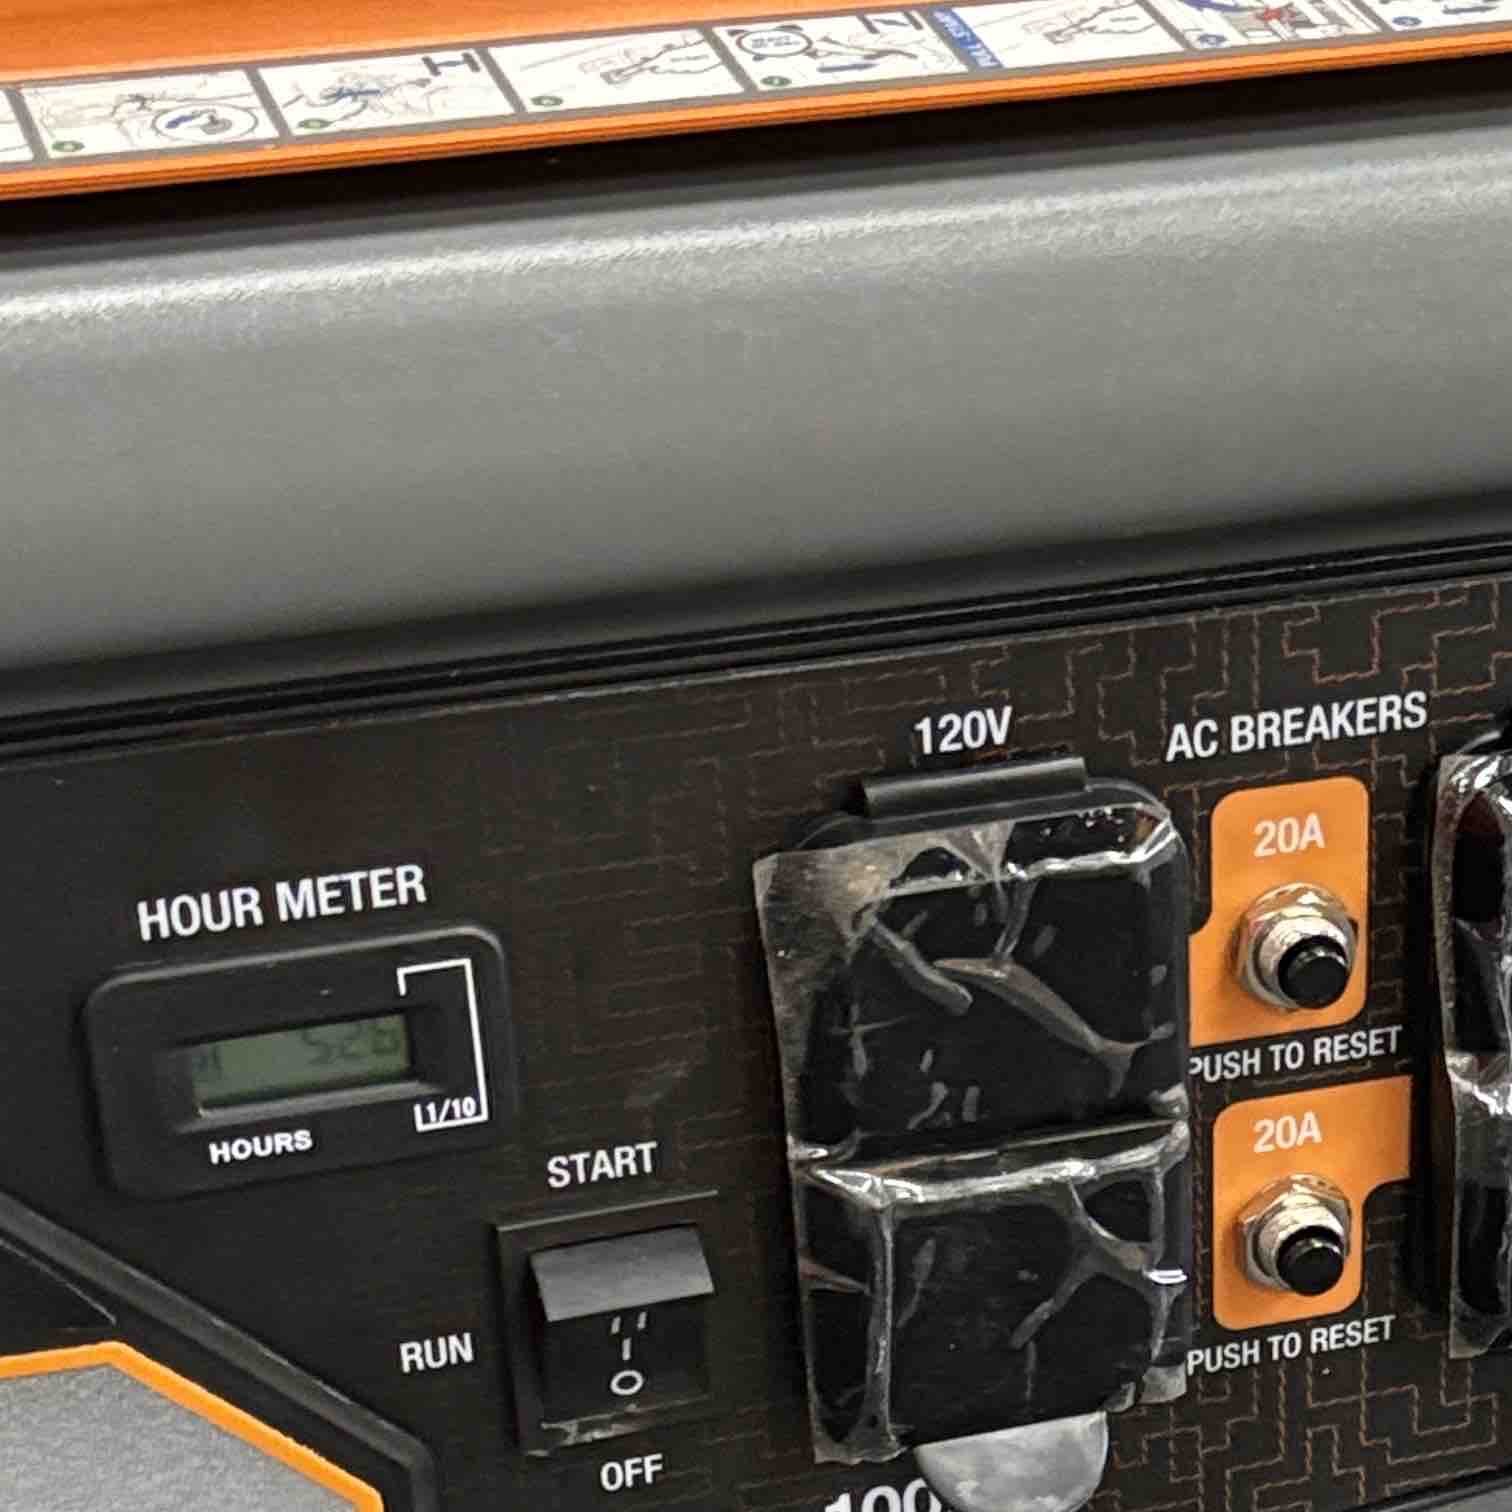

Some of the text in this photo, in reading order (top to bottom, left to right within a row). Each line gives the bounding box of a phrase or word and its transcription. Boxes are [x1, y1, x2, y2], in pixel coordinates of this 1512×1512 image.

[914, 706, 1013, 756] 120V
[1164, 691, 1429, 763] AC BREAKERS
[1252, 813, 1326, 858] 20A
[137, 864, 427, 941] HOUR METER
[1188, 1025, 1403, 1084] PUSH TO RESET
[424, 1096, 478, 1124] 1/10
[1253, 1111, 1322, 1154] 20A
[209, 1130, 312, 1165] HOURS
[547, 1141, 658, 1189] START
[400, 1332, 474, 1373] RUN
[1185, 1314, 1396, 1377] PUSH TO RESET
[600, 1453, 663, 1491] OFF
